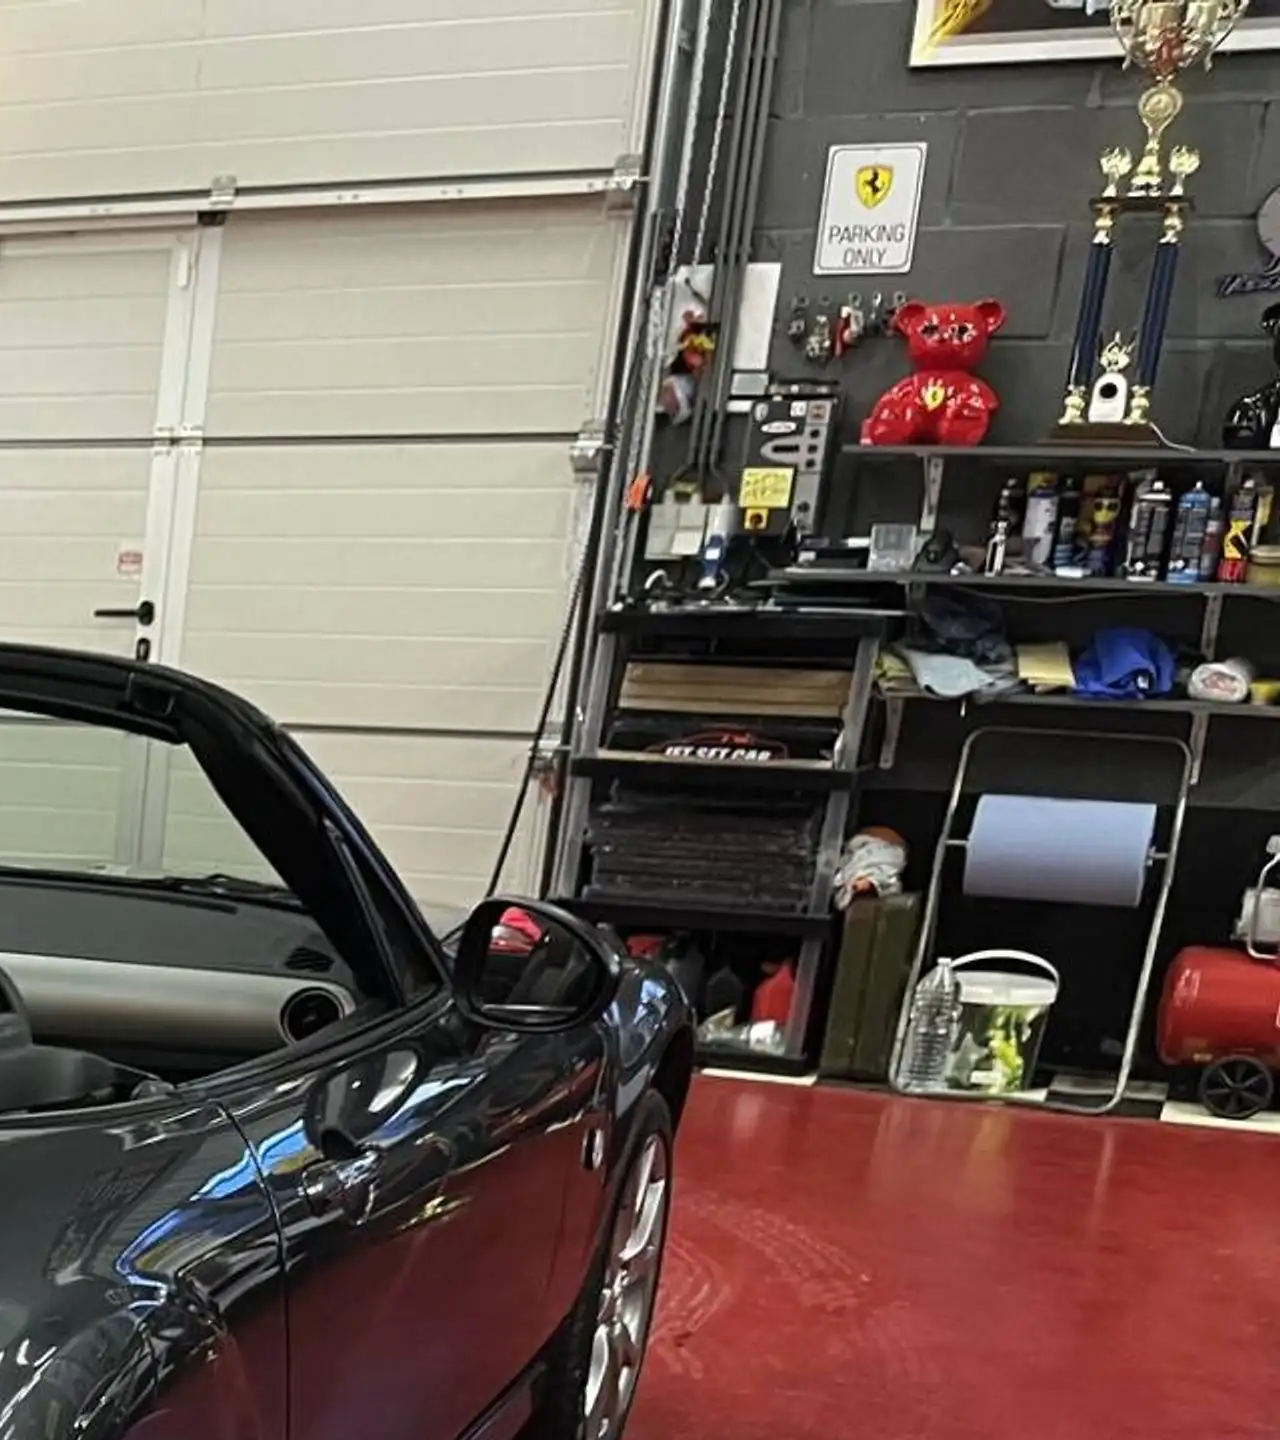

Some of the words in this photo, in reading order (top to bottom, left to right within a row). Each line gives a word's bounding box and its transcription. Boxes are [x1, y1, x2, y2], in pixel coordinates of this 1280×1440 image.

[828, 223, 906, 245] PARKING
[843, 247, 887, 267] ONLY
[664, 745, 695, 757] JET
[696, 746, 731, 759] SET
[731, 748, 772, 760] CAR
